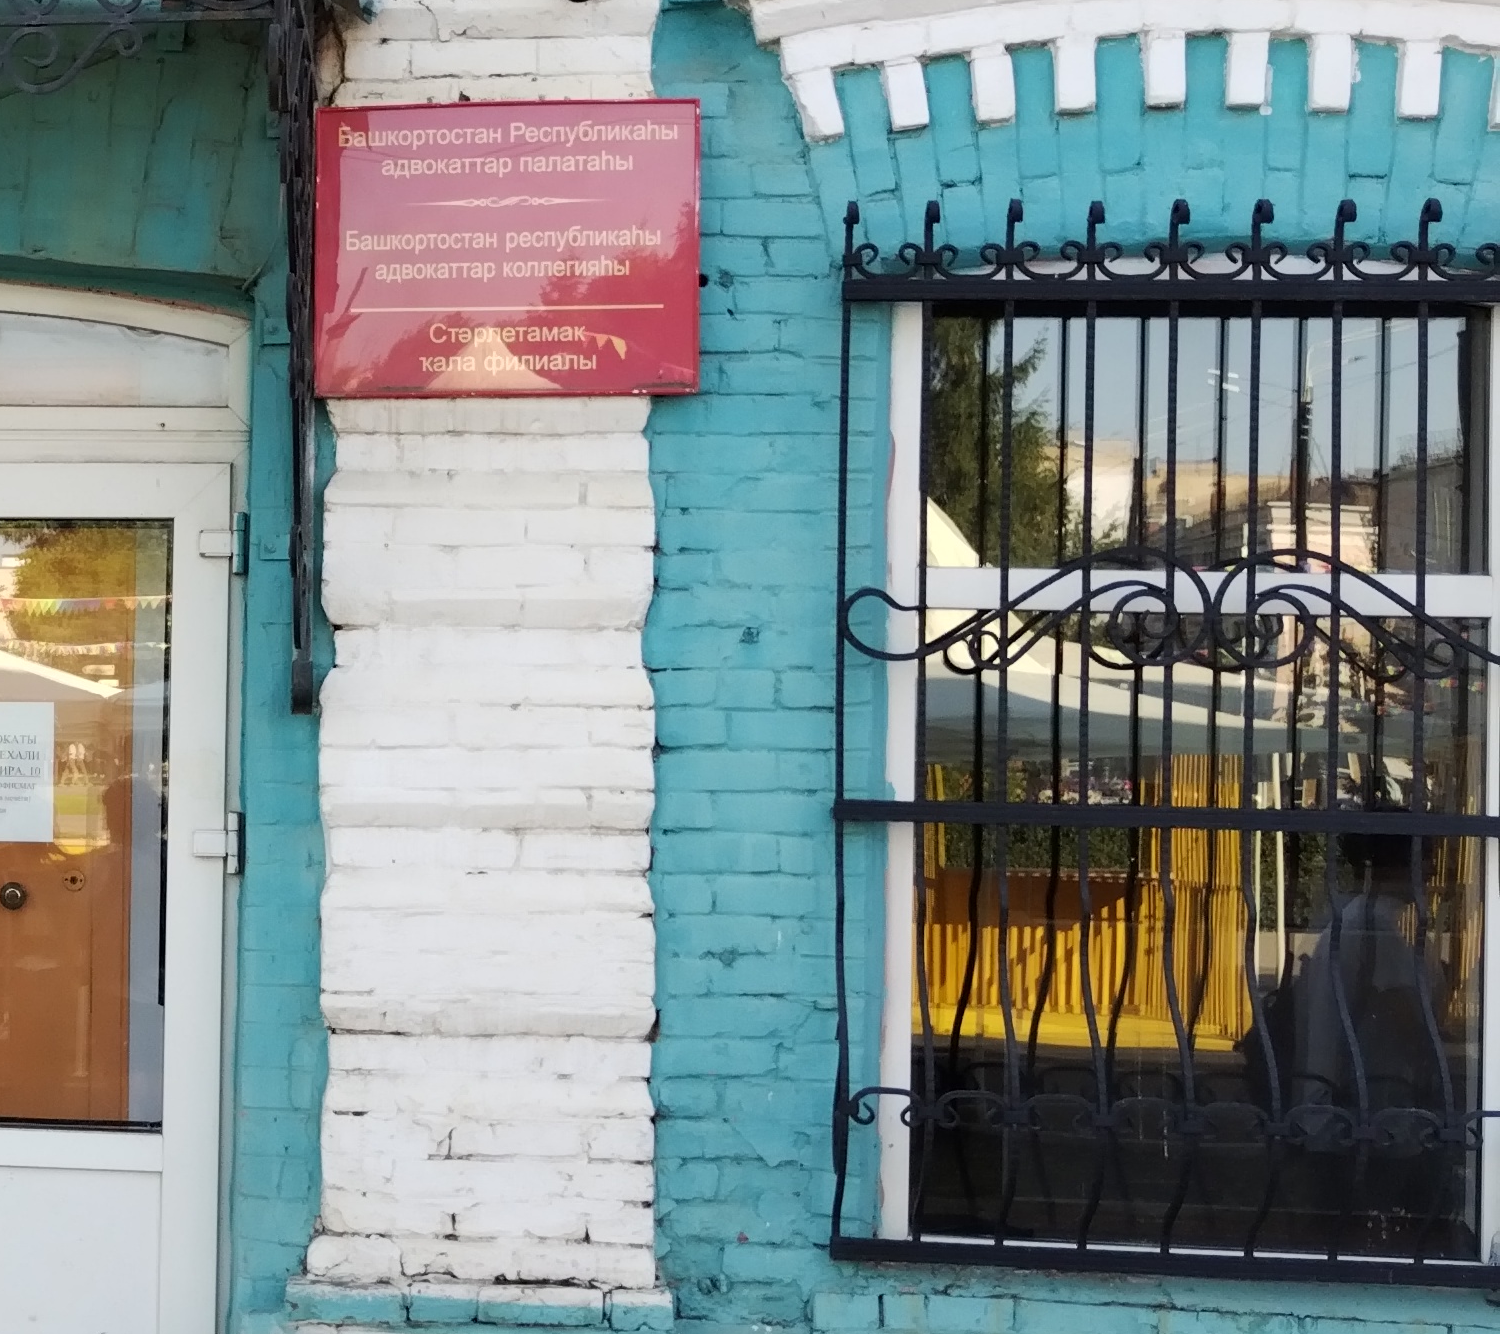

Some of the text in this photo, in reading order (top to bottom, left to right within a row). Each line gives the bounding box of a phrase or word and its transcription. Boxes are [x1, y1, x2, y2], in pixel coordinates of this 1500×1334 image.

[381, 157, 511, 178] адвокаттар
[375, 260, 496, 283] адвокаттар
[484, 352, 597, 376] филиалы
[29, 766, 41, 776] 10
